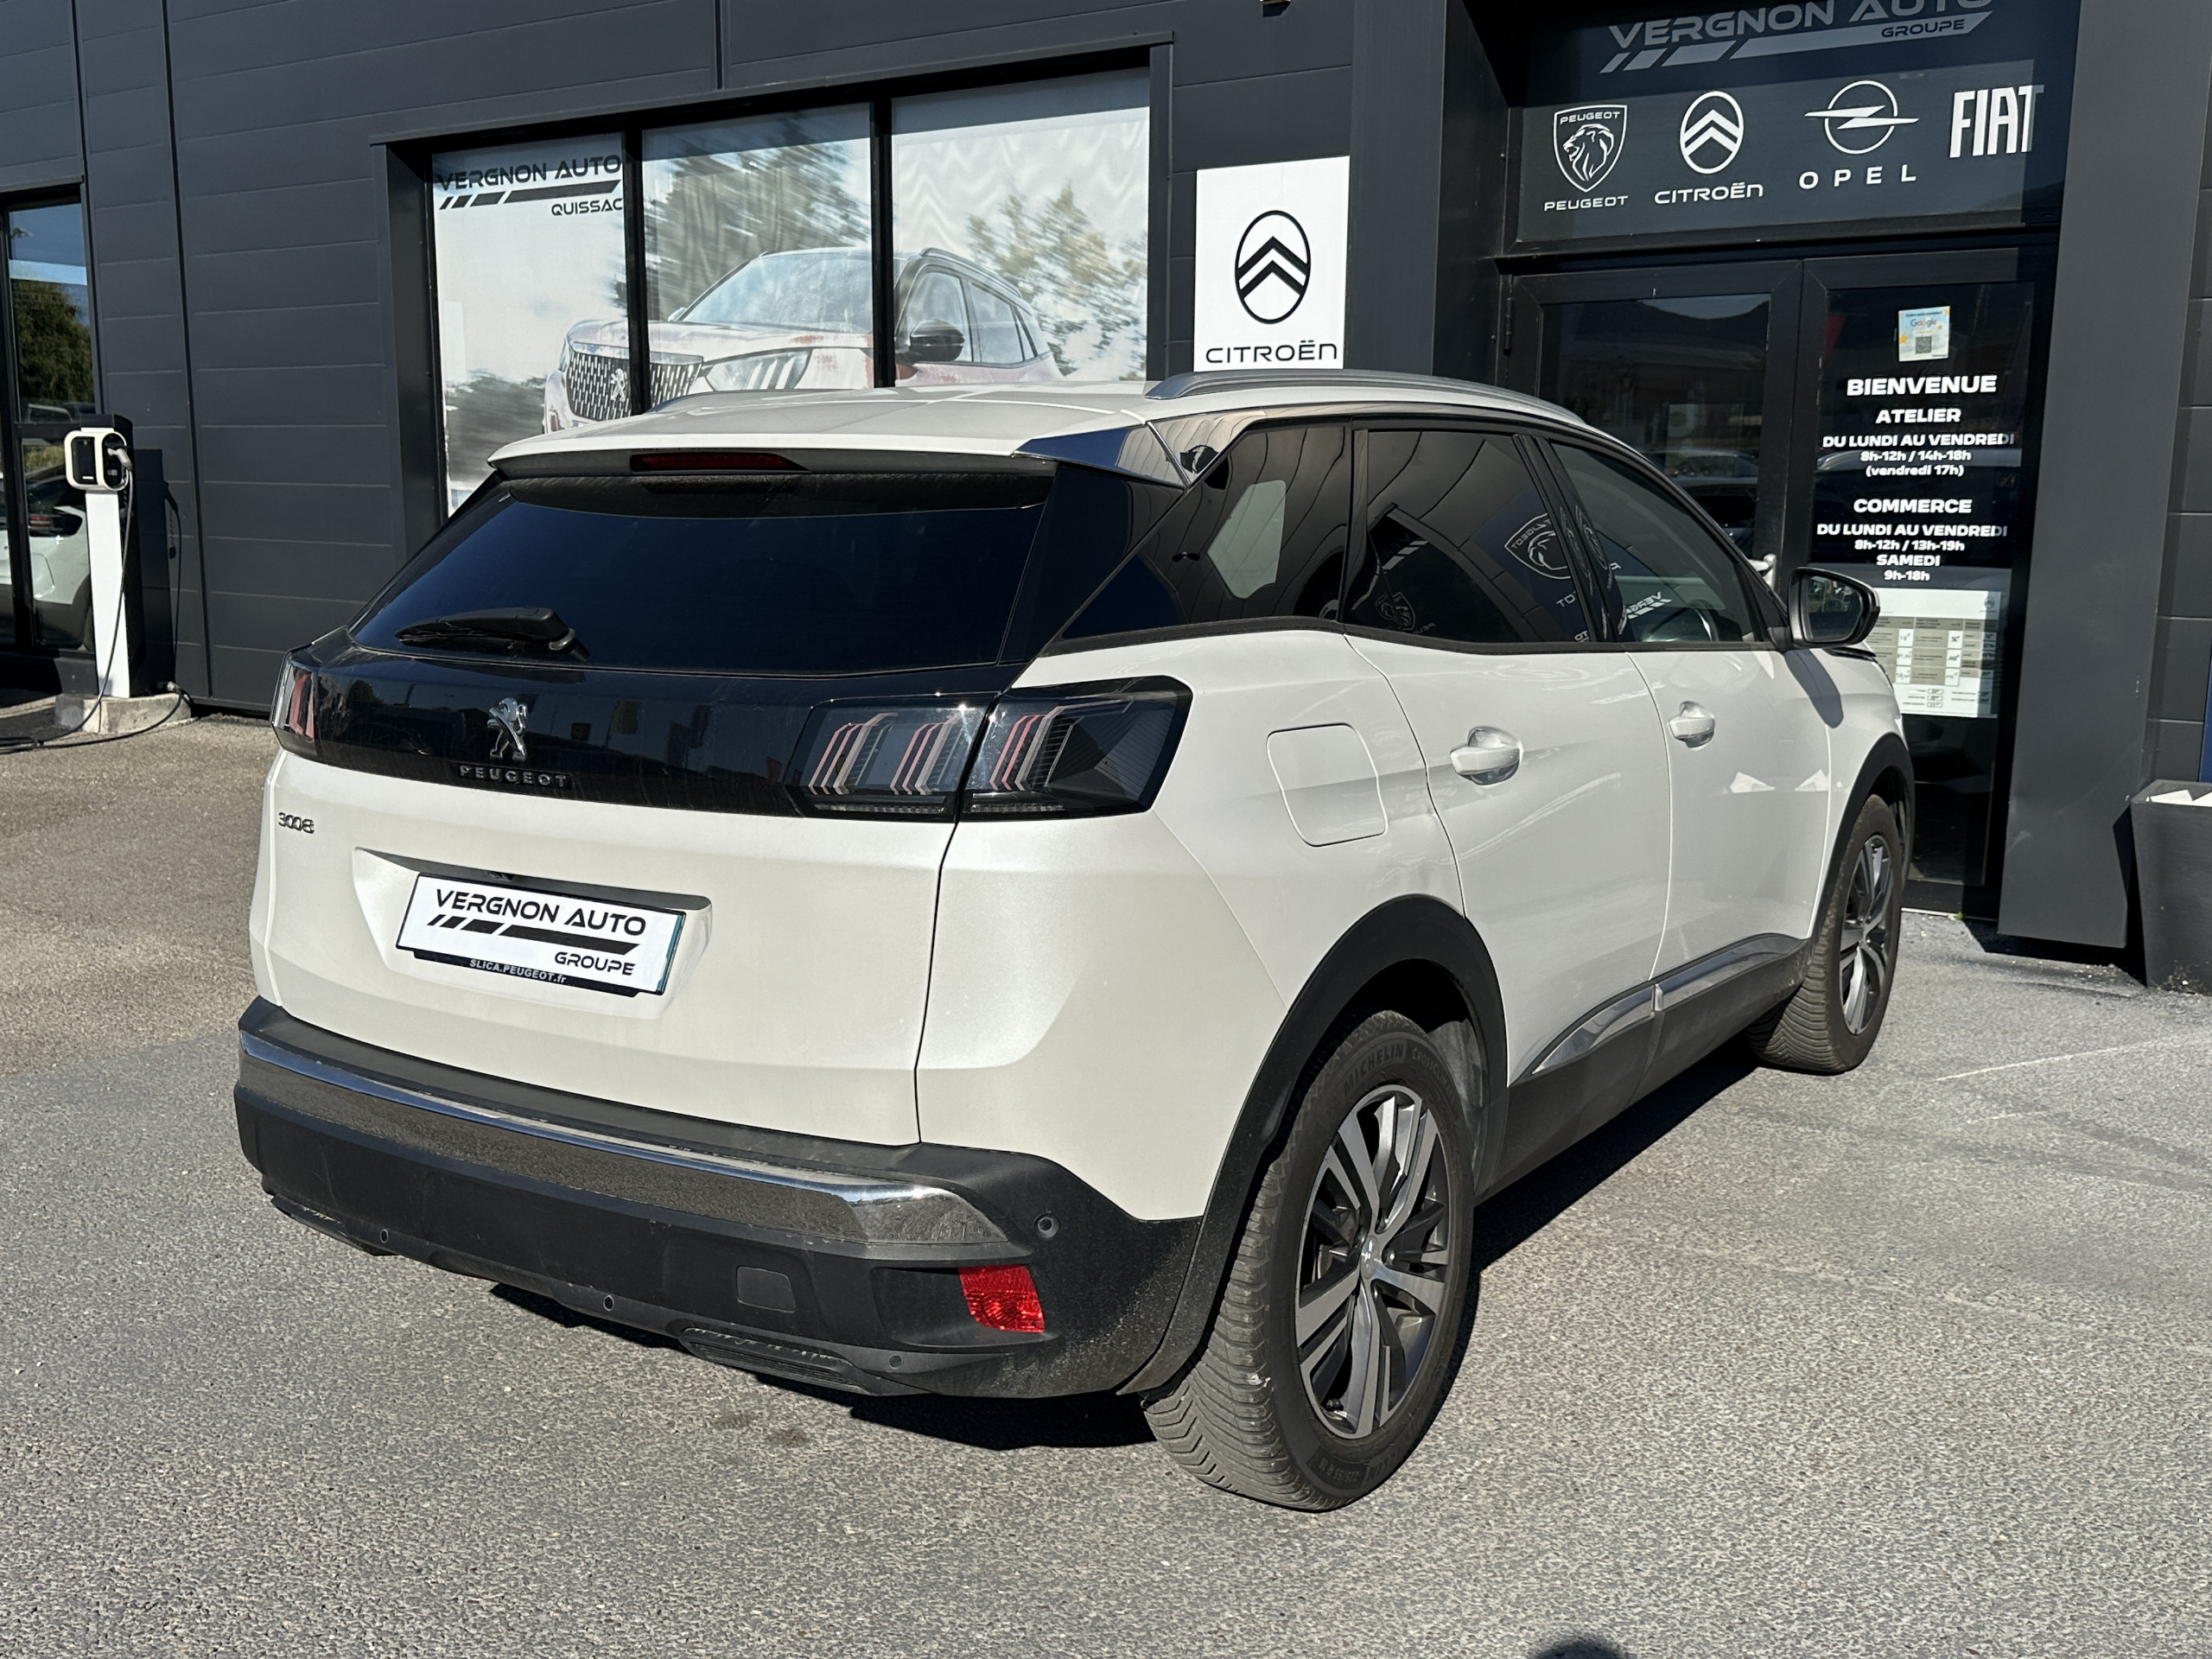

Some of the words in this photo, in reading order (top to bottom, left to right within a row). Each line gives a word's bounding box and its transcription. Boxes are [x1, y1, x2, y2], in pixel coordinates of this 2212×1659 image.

[1608, 0, 1834, 48] VERGNON
[1881, 19, 1965, 38] GROUPE
[1560, 111, 1620, 124] PEUGEOT
[1949, 84, 2044, 158] FIAT
[436, 162, 547, 191] VERGNON
[554, 155, 622, 180] AUTO
[1799, 164, 1916, 189] OPEL
[551, 198, 623, 215] QUISSAC
[1543, 195, 1629, 212] PEUGEOT
[1847, 374, 1998, 397] BIENVENUE
[1875, 408, 1962, 424] ATELIER
[1822, 435, 1847, 448] DU
[1848, 435, 1898, 448] LUNDI
[1900, 435, 1926, 447] AU
[1928, 433, 2015, 446] VENDREDI
[1860, 450, 1907, 462] 8h-12h
[1917, 449, 1972, 461] 14h-18h
[1866, 464, 1932, 478] (vendredi
[1933, 464, 1965, 477] 17h)
[1853, 498, 1973, 514] COMMERCE
[1816, 523, 1840, 536] DU
[1842, 524, 1892, 536] LUNDI
[1893, 524, 1920, 537] AU
[1922, 524, 2008, 537] VENDREDI
[1854, 538, 1901, 550] 8h-12h
[1910, 539, 1966, 551] 13h-19h
[1876, 554, 1941, 567] SAMEDI
[1884, 569, 1930, 582] 9h-18h
[459, 764, 567, 788] PEUGEOT
[277, 811, 315, 835] 3008
[435, 888, 560, 923] VERGNON
[563, 907, 647, 937] AUTO
[469, 958, 567, 984] SLICA.PEUGEOT.fr
[554, 951, 636, 976] GROUPE
[1343, 1043, 1404, 1096] MICHELIN
